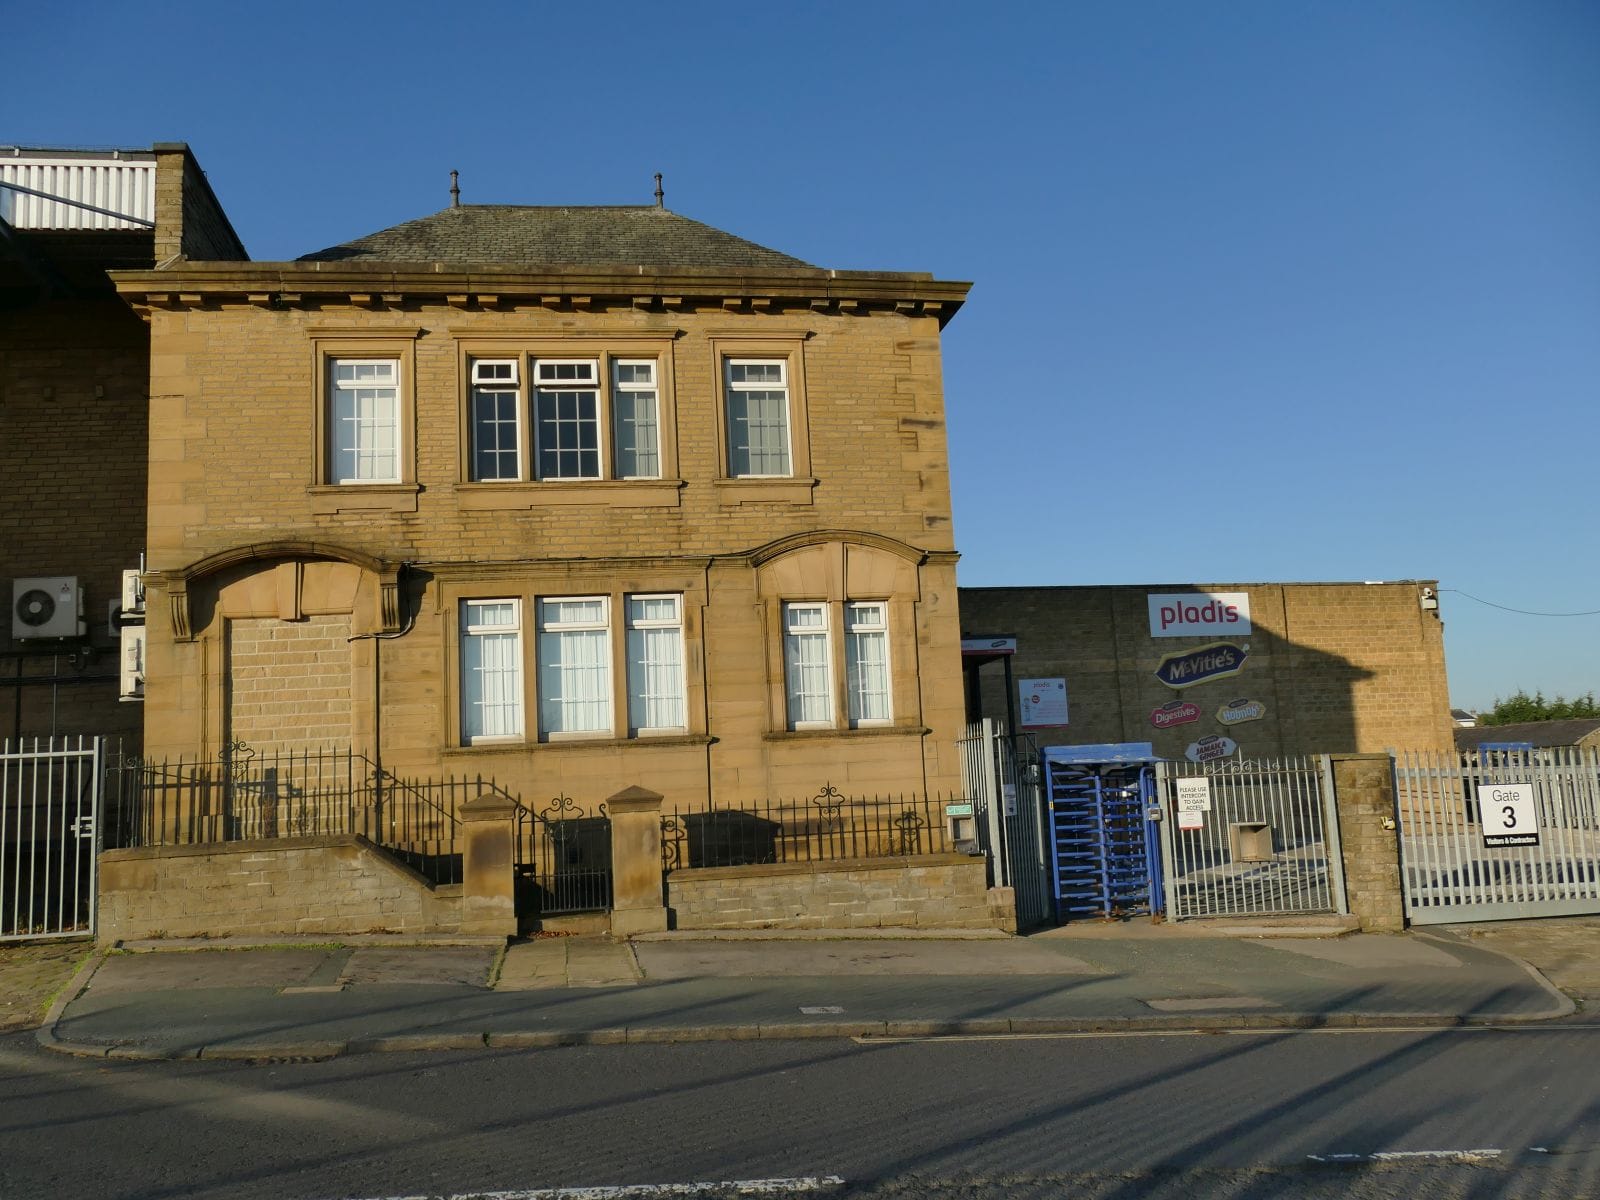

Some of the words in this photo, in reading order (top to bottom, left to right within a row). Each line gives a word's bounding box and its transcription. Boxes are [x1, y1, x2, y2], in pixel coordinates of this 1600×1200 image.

[1160, 600, 1239, 630] pladis
[1170, 649, 1235, 681] McVitie's
[1155, 707, 1196, 724] Digestives
[1196, 740, 1227, 756] JAMAICA
[1492, 789, 1520, 802] Gate
[1502, 805, 1517, 828] 3
